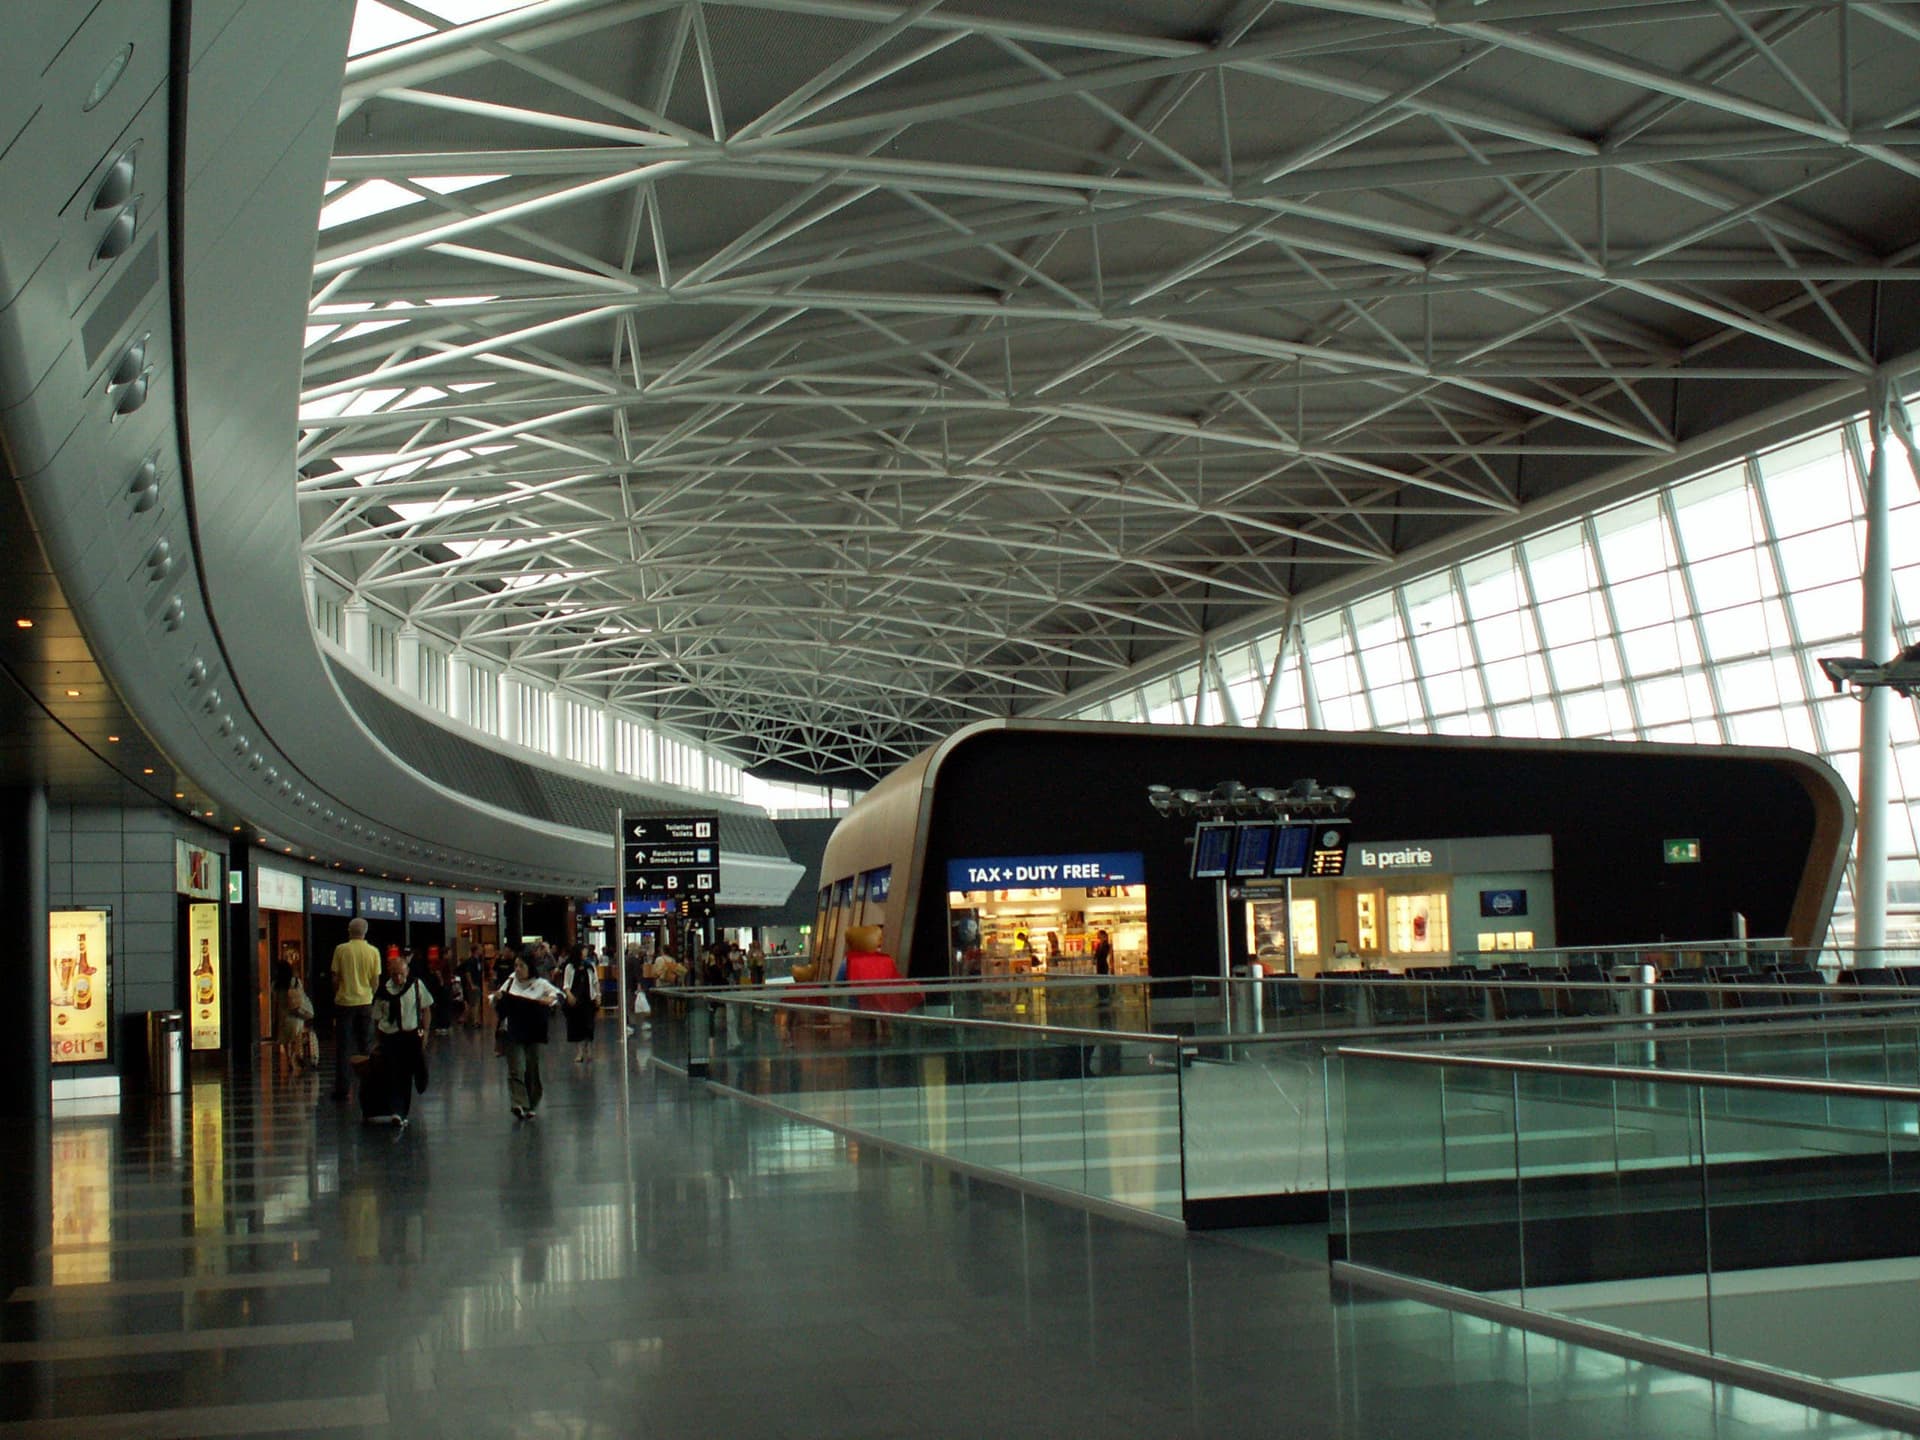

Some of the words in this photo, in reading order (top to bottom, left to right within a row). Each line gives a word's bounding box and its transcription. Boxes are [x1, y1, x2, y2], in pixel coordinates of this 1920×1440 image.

[1361, 849, 1376, 866] la
[1378, 847, 1432, 869] prairie
[1062, 864, 1099, 879] FREE
[667, 876, 678, 889] B
